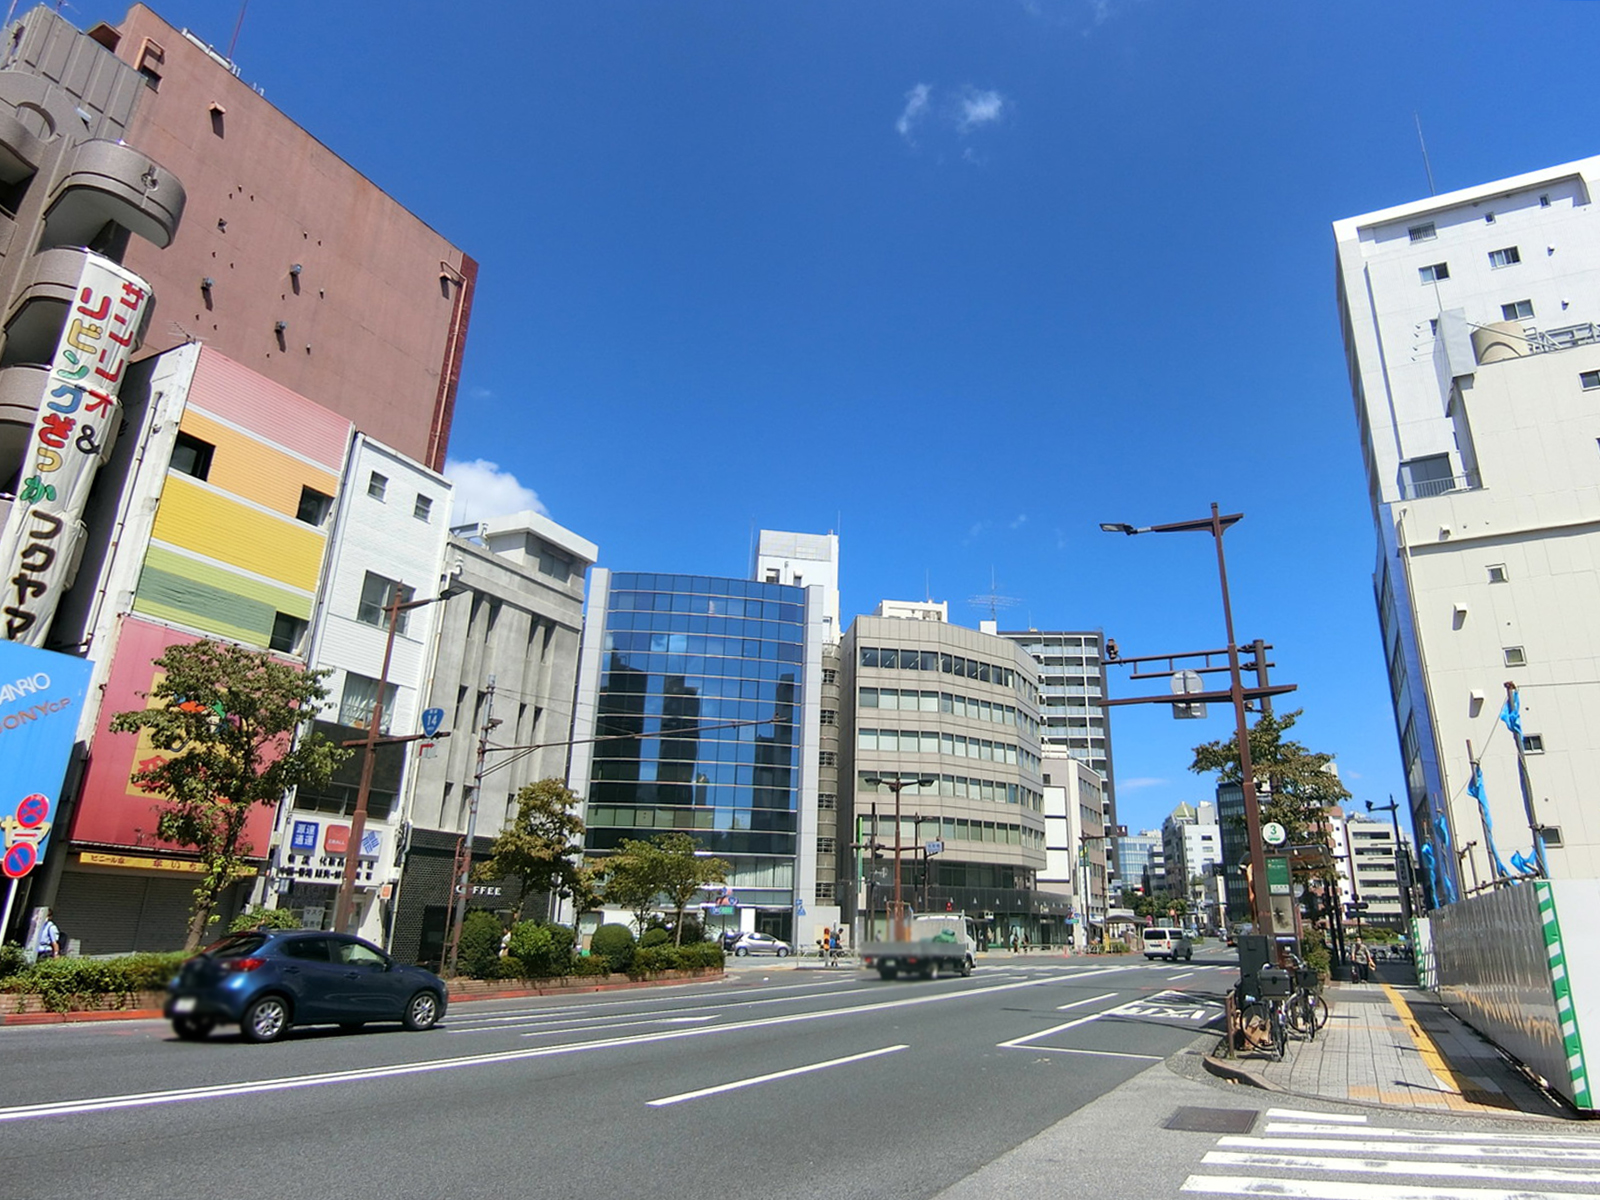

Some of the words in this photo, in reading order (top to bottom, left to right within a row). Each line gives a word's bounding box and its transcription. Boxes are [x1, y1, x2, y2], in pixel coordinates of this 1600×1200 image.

[5, 509, 63, 641] フクヤマ
[0, 700, 50, 733] ONY
[427, 715, 438, 726] 14
[1270, 824, 1278, 836] 3
[456, 885, 502, 896] CFFEE
